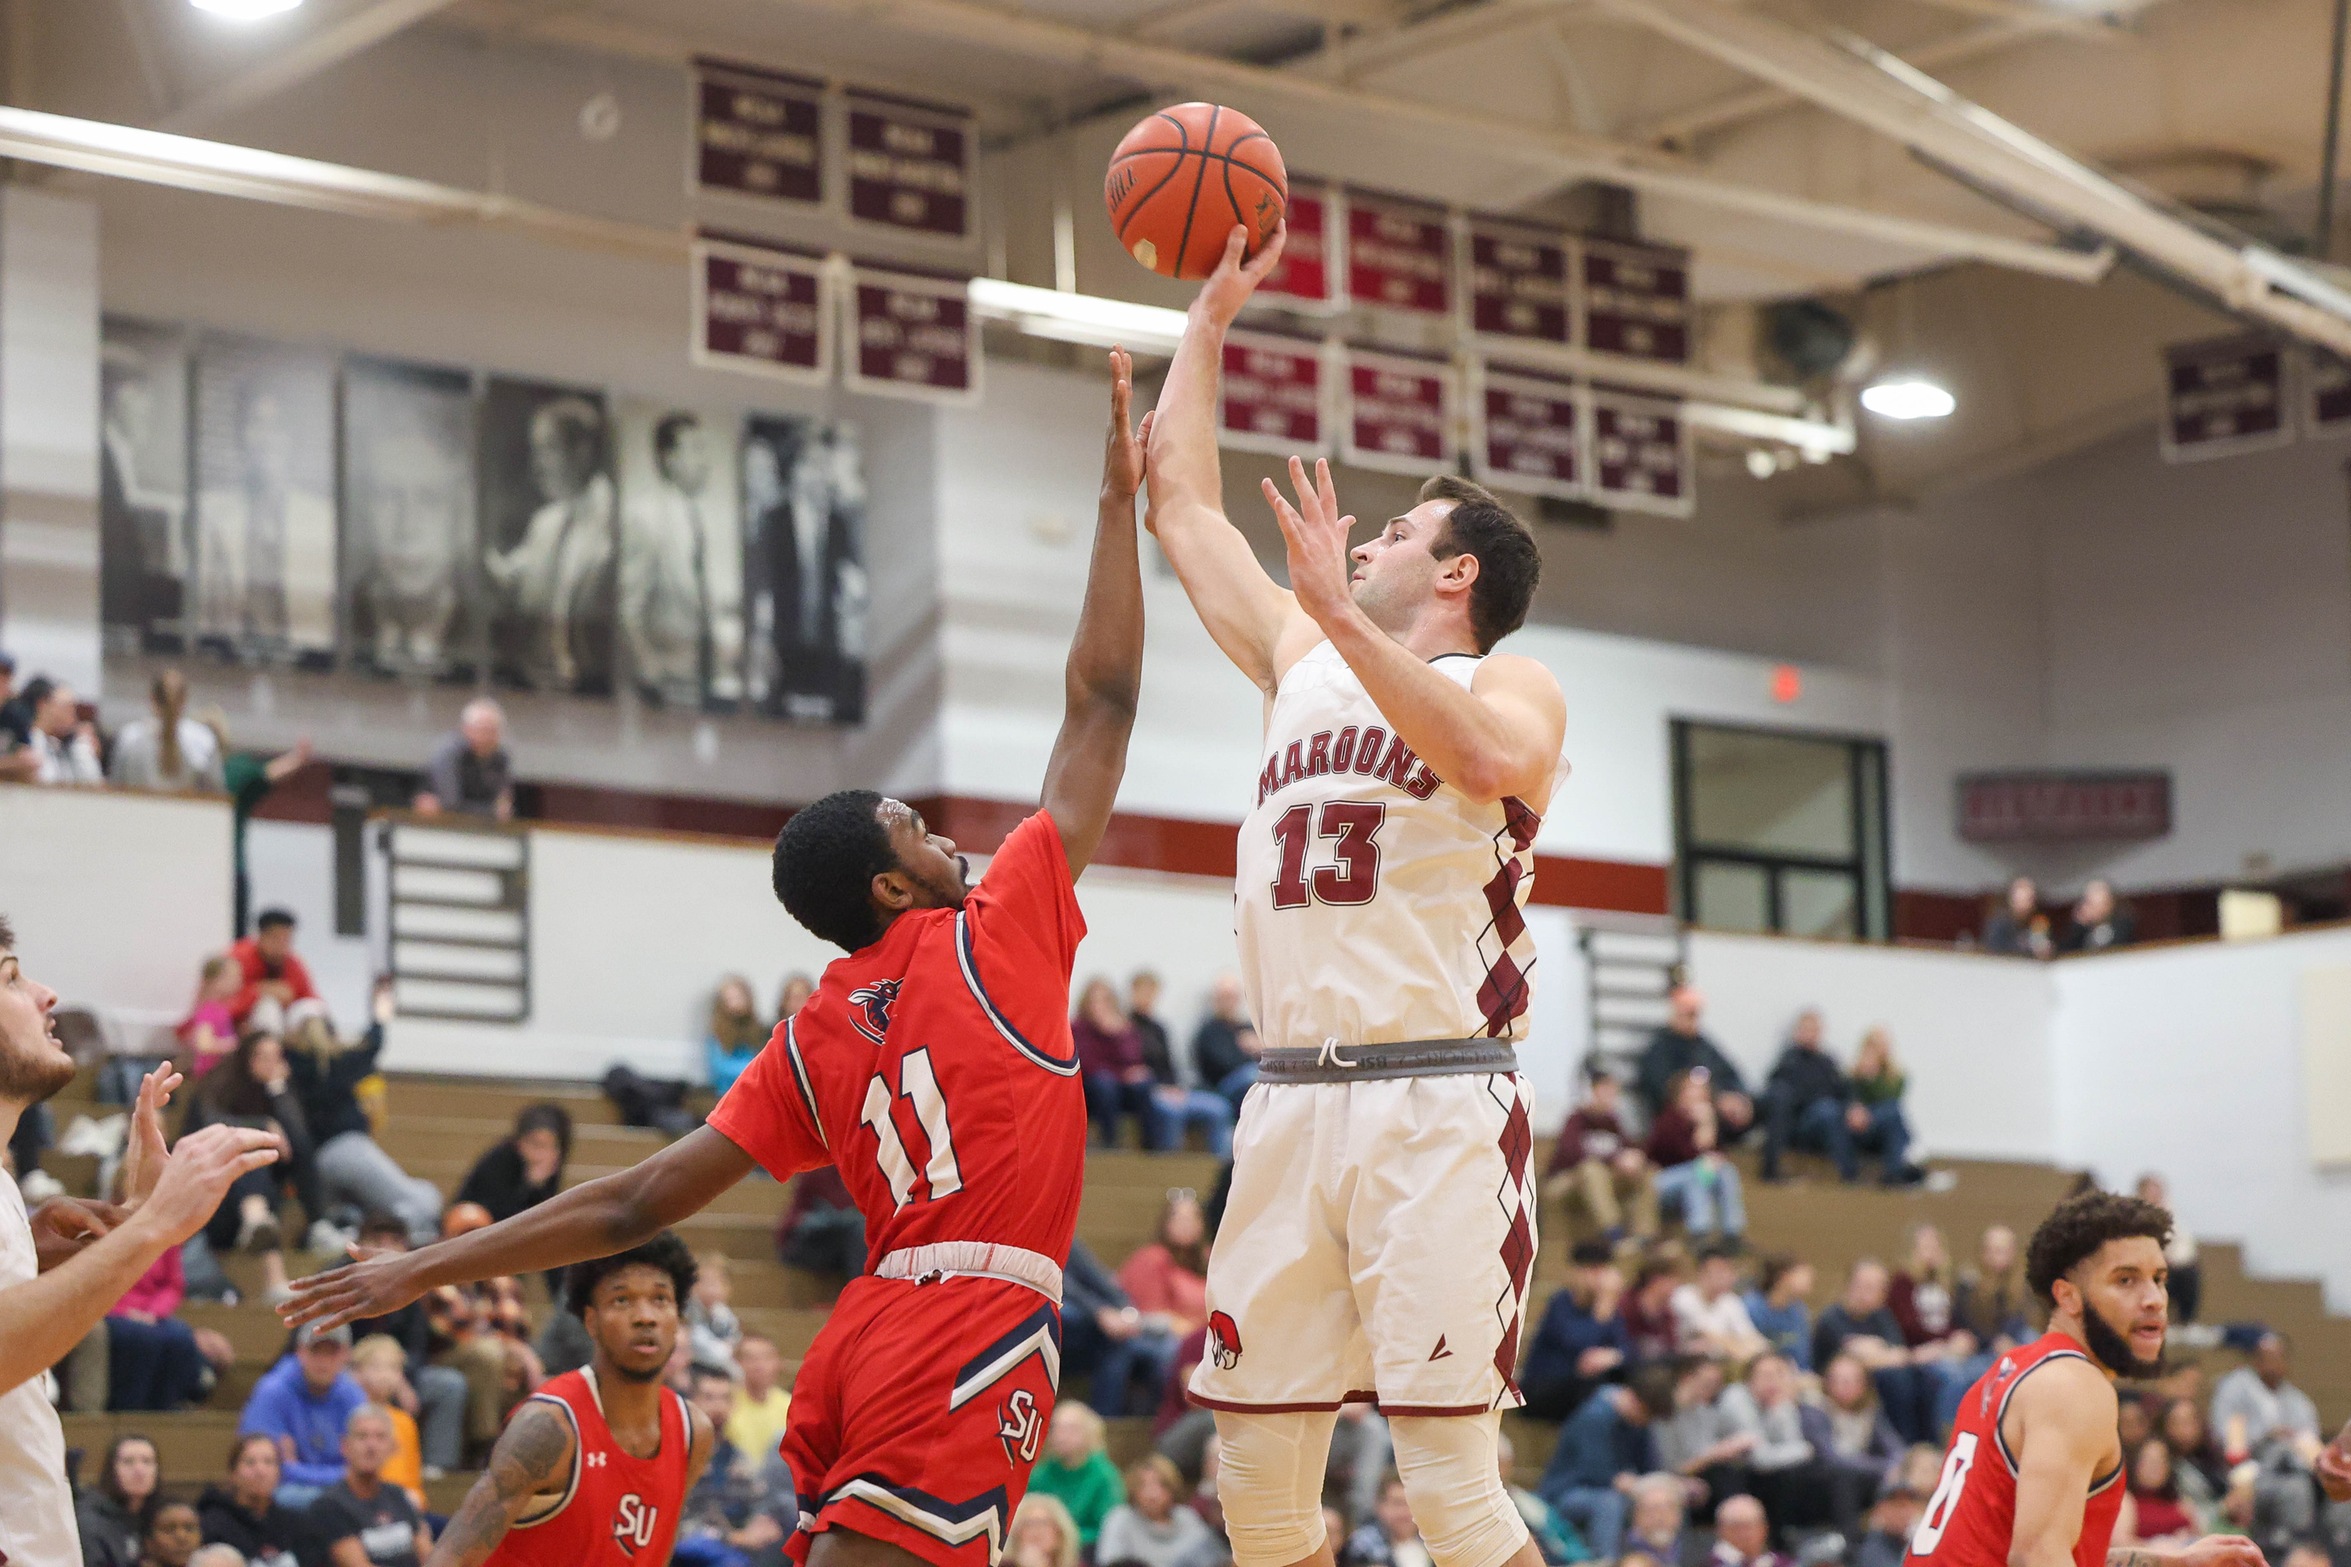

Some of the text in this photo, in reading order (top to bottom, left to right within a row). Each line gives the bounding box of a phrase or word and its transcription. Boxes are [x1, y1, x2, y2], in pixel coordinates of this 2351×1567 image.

[1257, 725, 1444, 809] MAROONS
[1269, 800, 1386, 911] 13
[860, 1045, 964, 1218] 11
[999, 1388, 1043, 1462] SU
[614, 1493, 658, 1548] SU
[1910, 1430, 1979, 1557] 0
